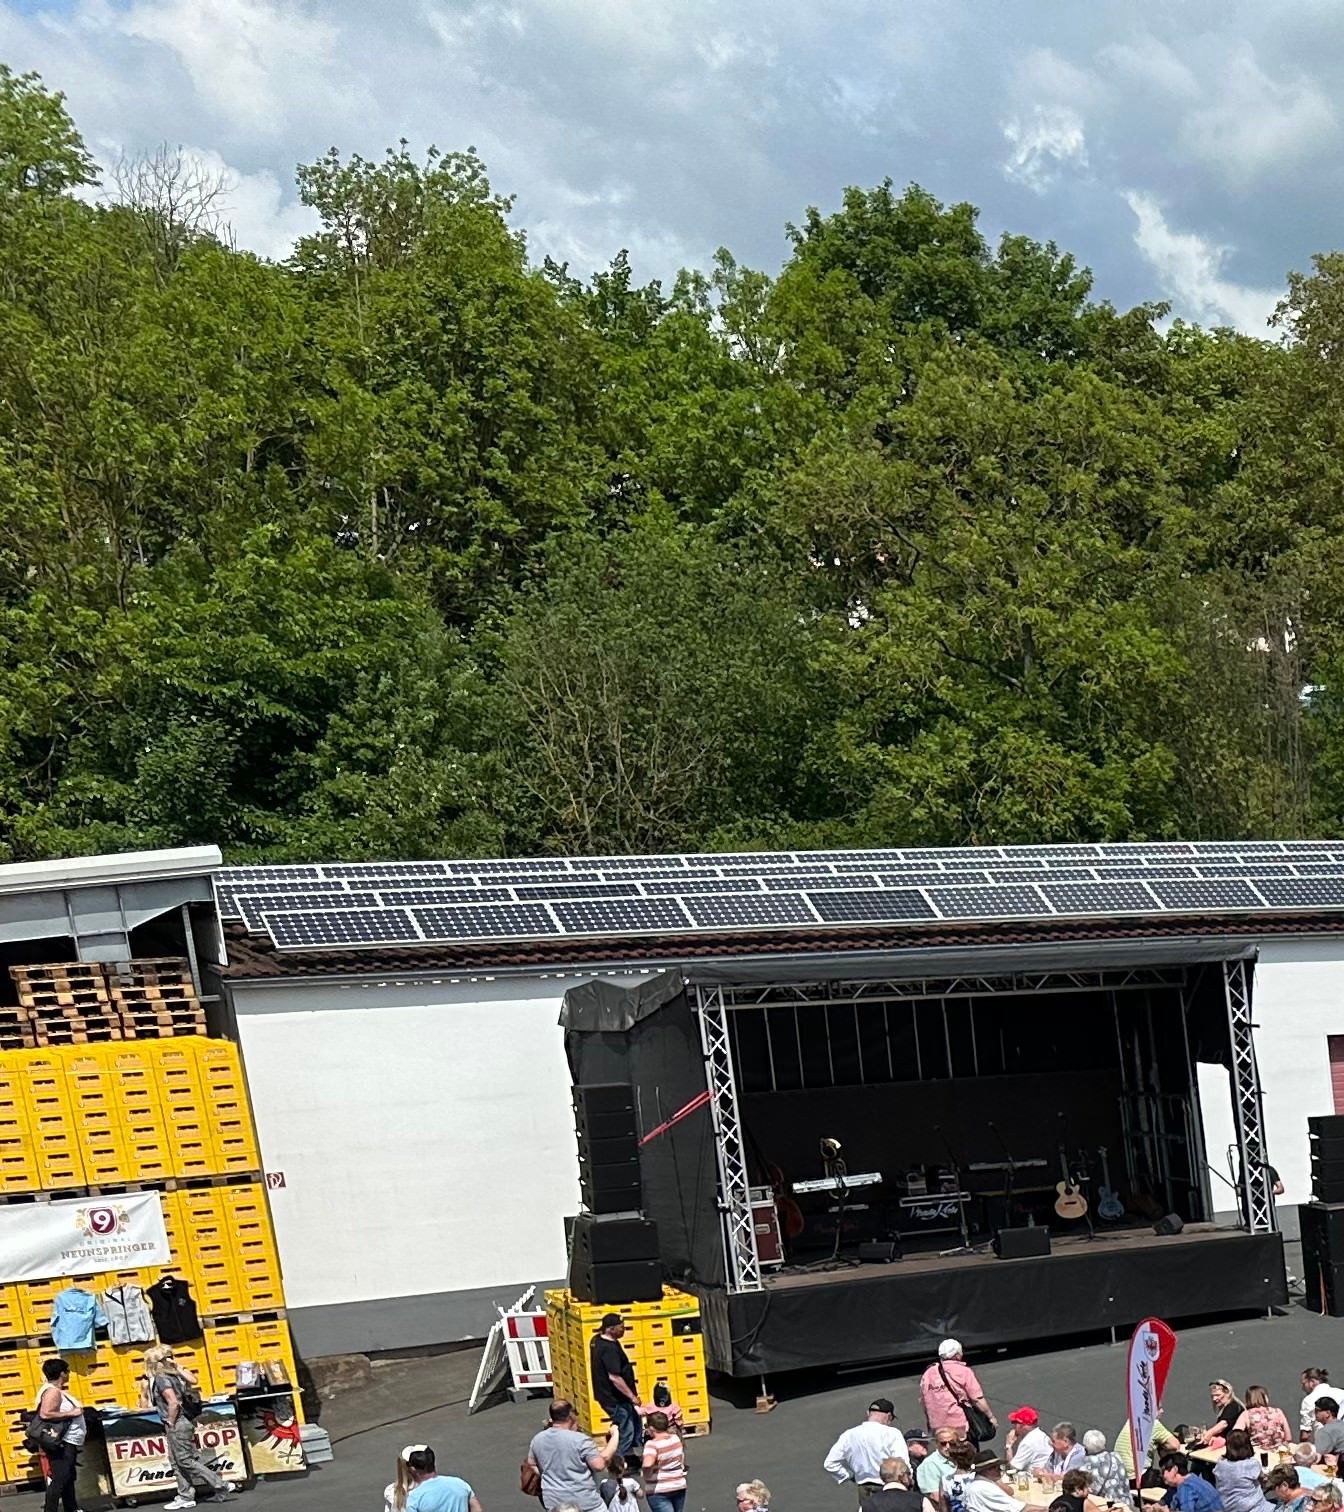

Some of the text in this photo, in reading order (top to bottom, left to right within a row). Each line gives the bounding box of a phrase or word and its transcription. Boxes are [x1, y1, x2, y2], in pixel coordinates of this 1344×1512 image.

[93, 1210, 111, 1231] 9
[61, 1242, 156, 1259] NEUNSPRINGER
[114, 1429, 236, 1459] FANHOP
